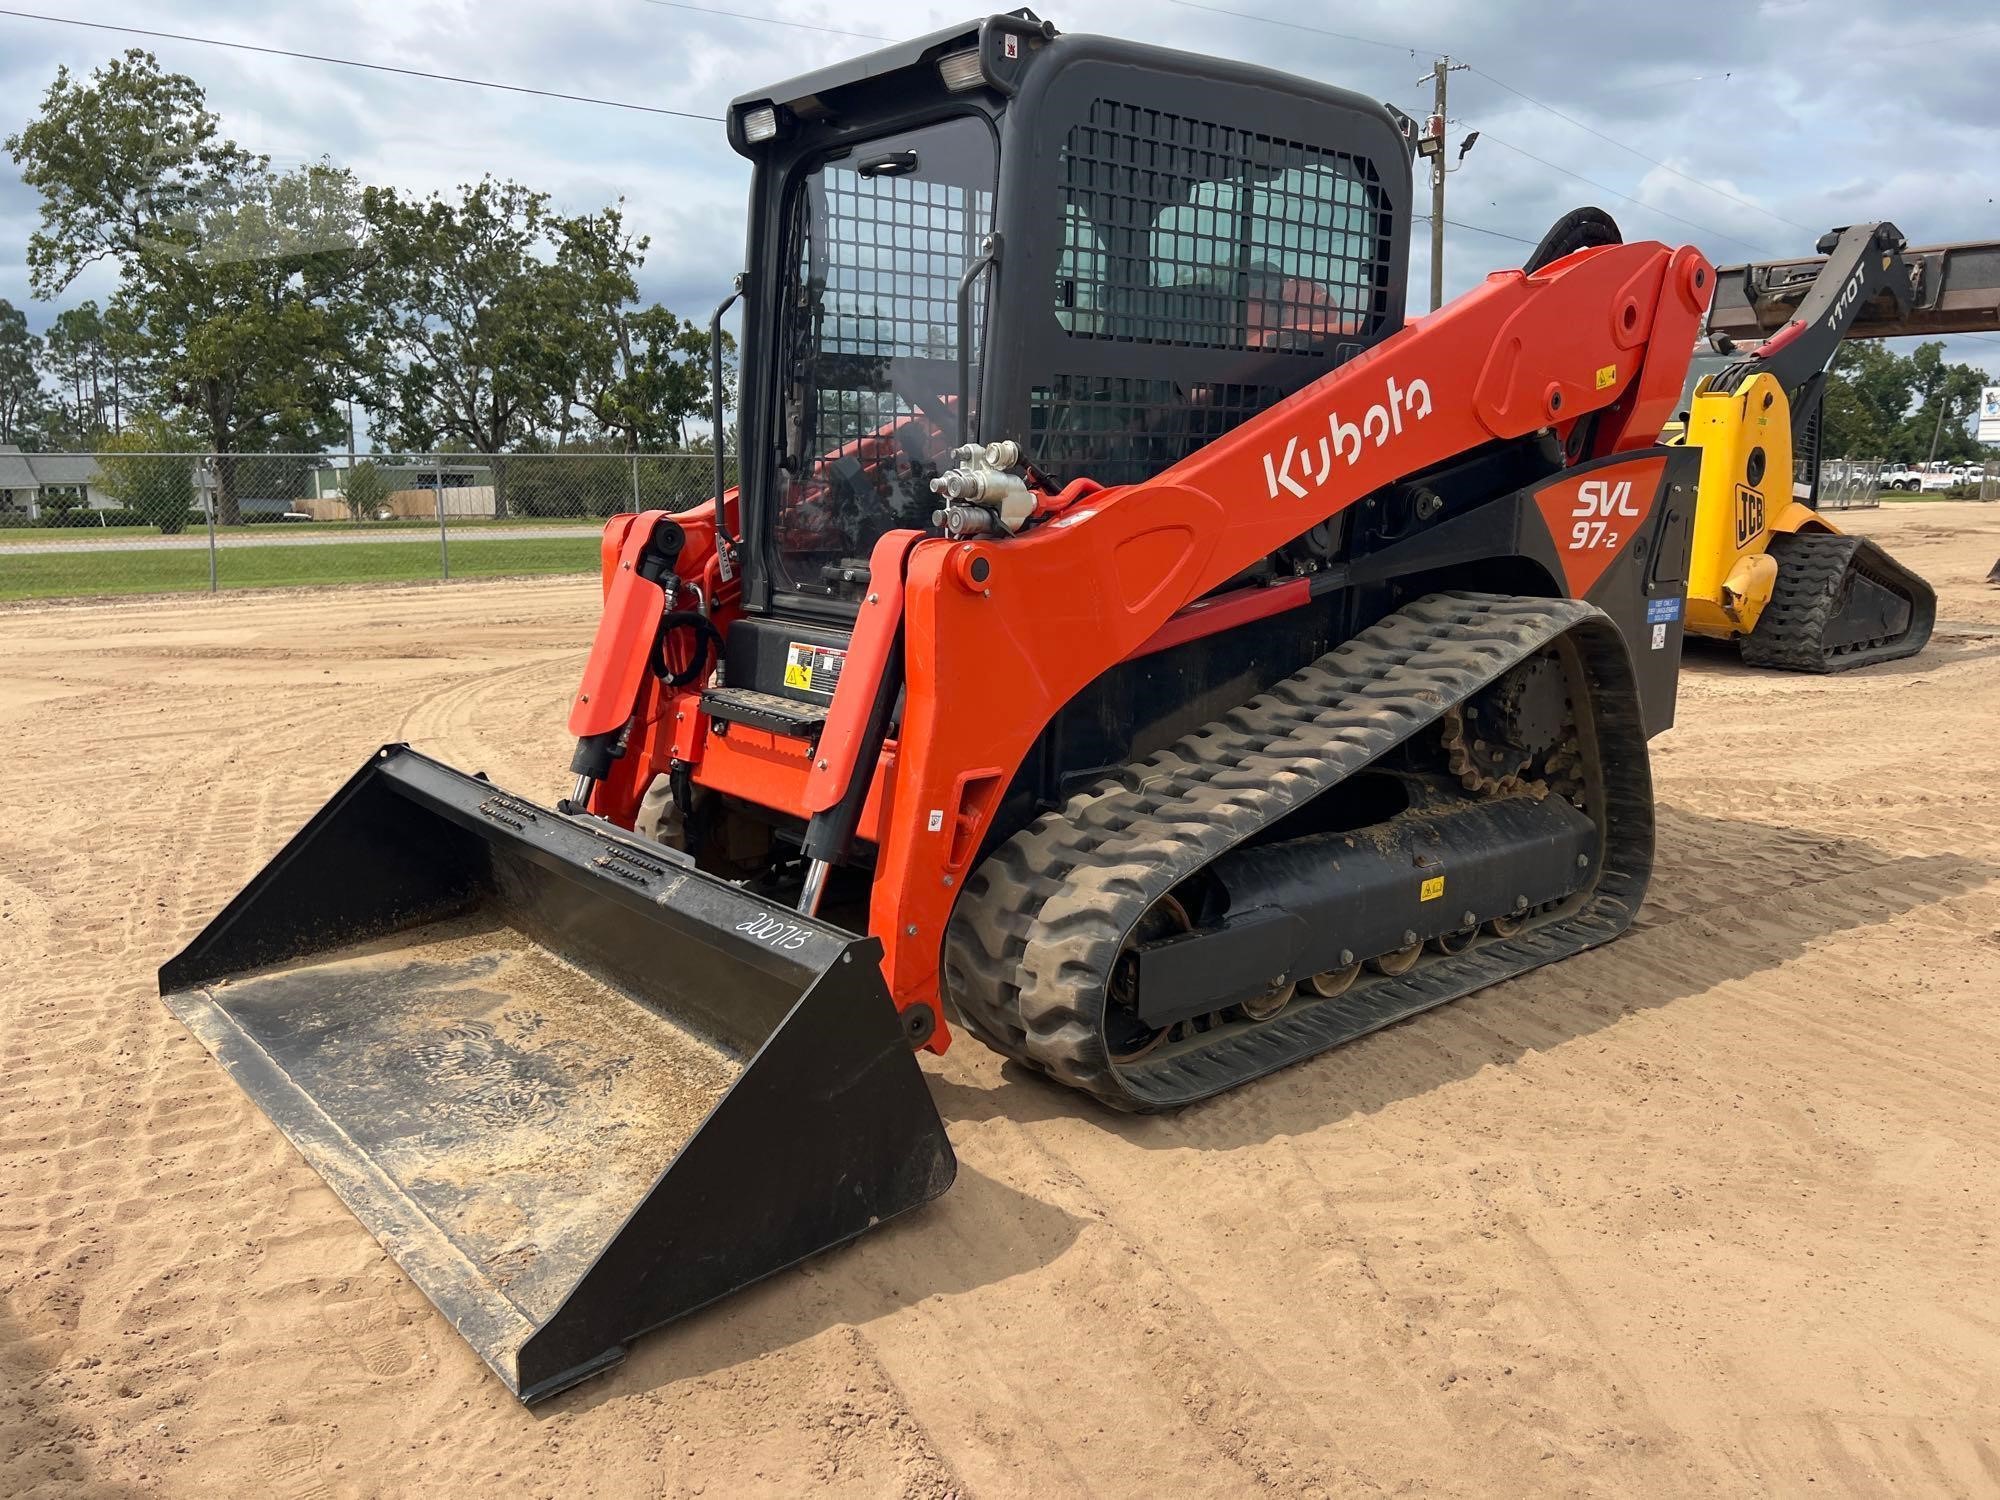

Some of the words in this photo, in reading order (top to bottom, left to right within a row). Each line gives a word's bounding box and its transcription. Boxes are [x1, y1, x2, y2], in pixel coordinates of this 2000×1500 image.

[1828, 261, 1865, 331] 1110T
[1263, 376, 1432, 499] Kubota
[1572, 481, 1639, 517] SVL
[1738, 491, 1763, 542] JCB
[1569, 521, 1618, 550] 97-2
[735, 912, 813, 949] 200713
